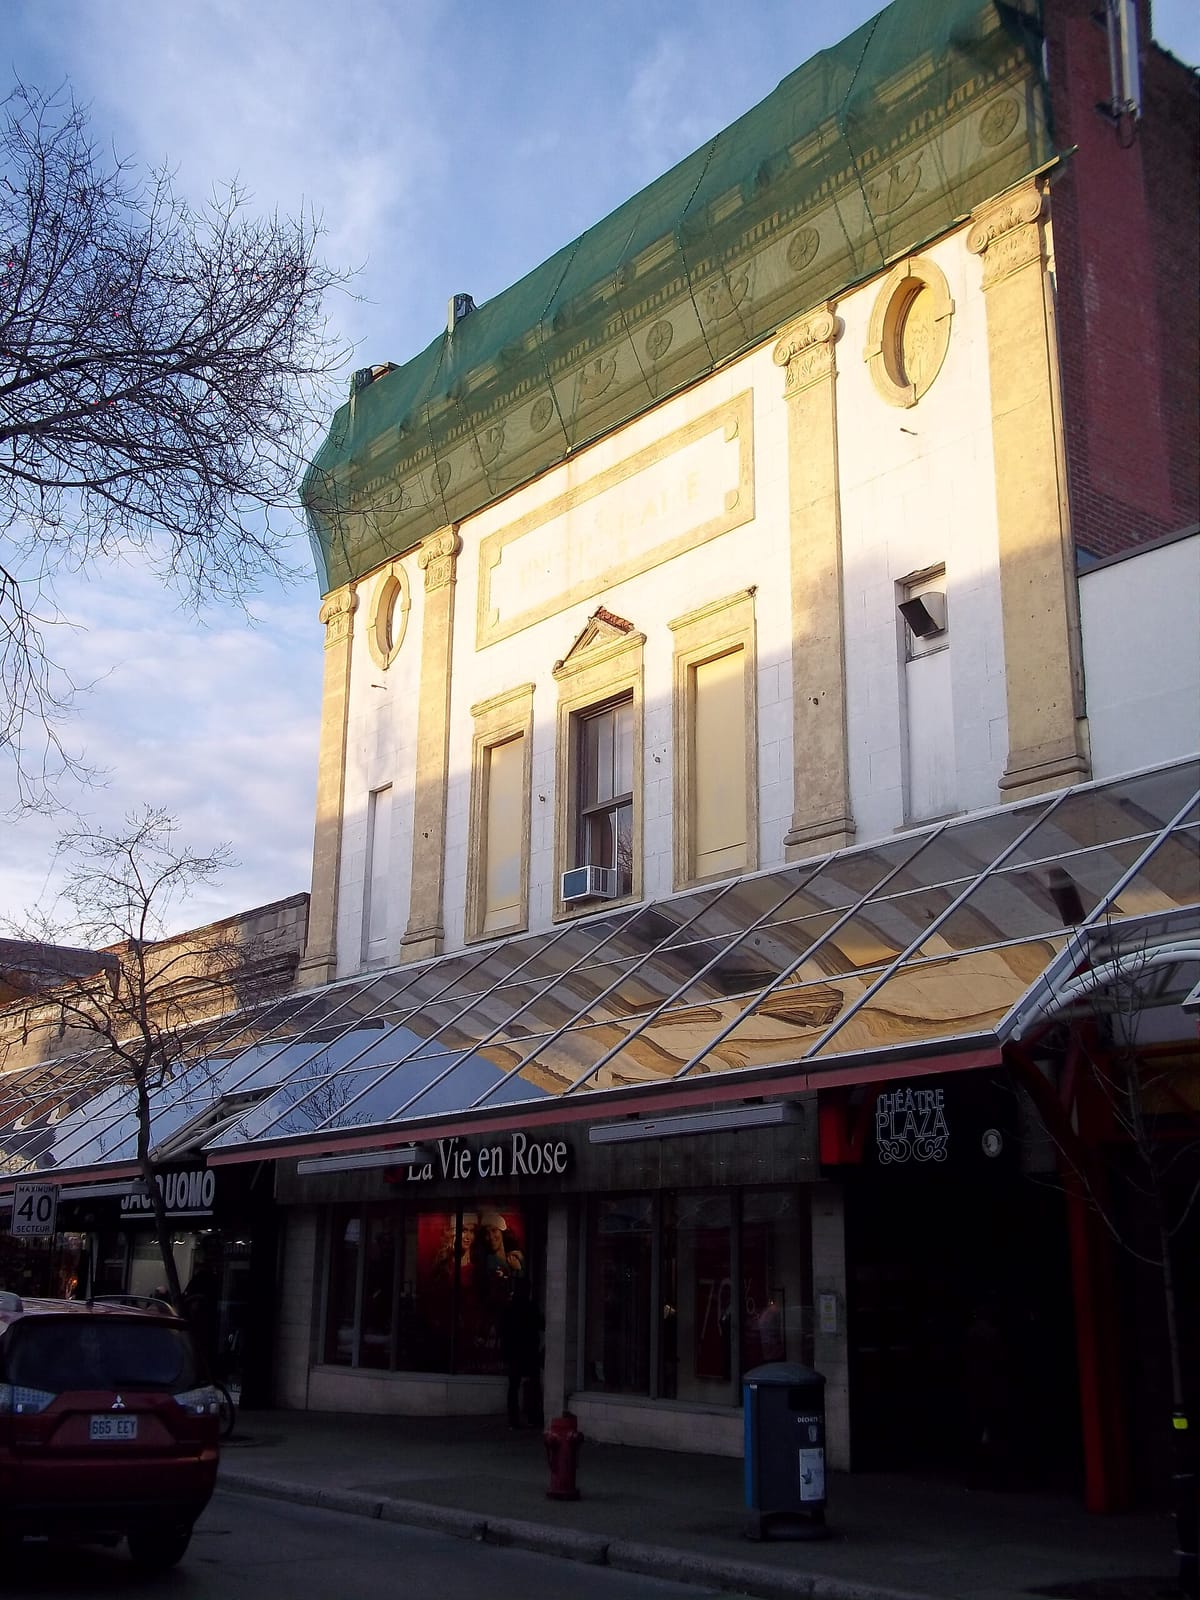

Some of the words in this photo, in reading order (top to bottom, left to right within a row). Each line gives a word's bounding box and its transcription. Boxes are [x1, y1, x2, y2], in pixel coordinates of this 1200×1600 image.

[876, 1088, 944, 1114] THÉÂTRE
[875, 1107, 950, 1140] PLAZA
[407, 1142, 434, 1181] La
[437, 1137, 472, 1179] Vie
[478, 1146, 504, 1177] en
[509, 1132, 568, 1175] Rose
[18, 1184, 54, 1193] MAXIMUM
[17, 1194, 52, 1222] 40
[16, 1225, 50, 1233] SECTEUR
